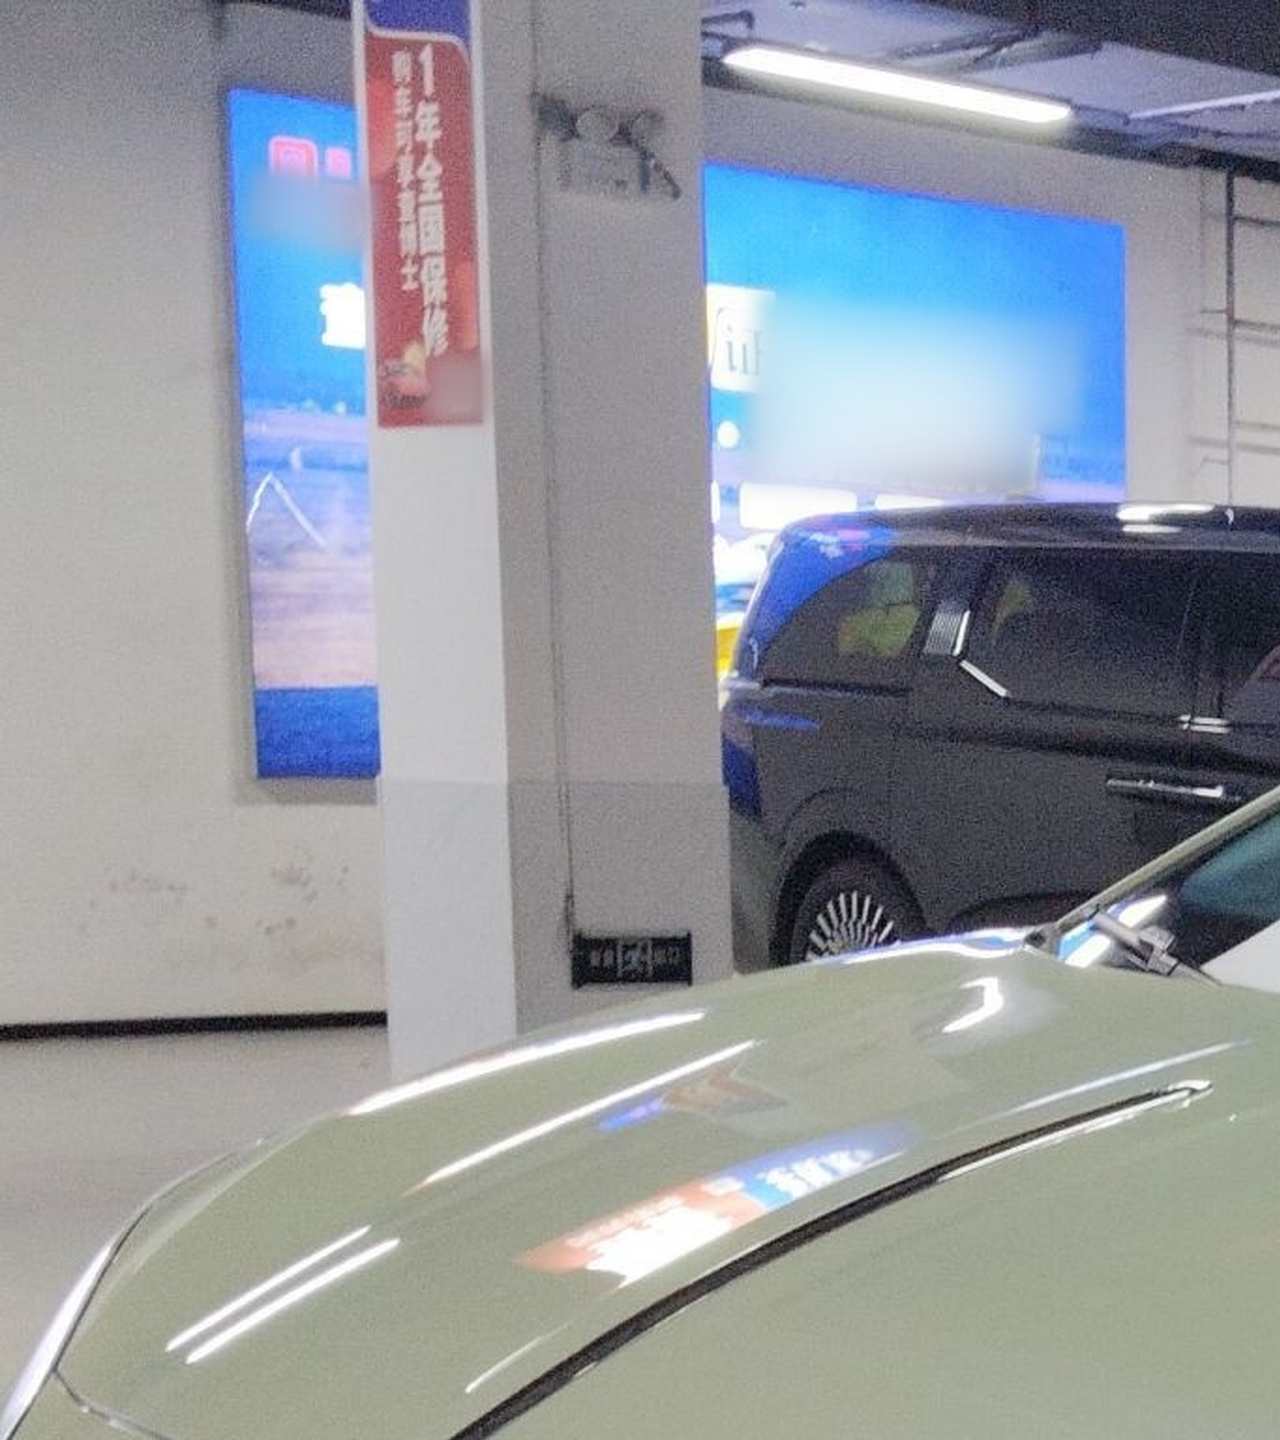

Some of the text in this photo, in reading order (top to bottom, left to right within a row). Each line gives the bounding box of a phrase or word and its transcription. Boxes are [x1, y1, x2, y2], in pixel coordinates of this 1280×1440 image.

[414, 43, 449, 357] 1年全国保修
